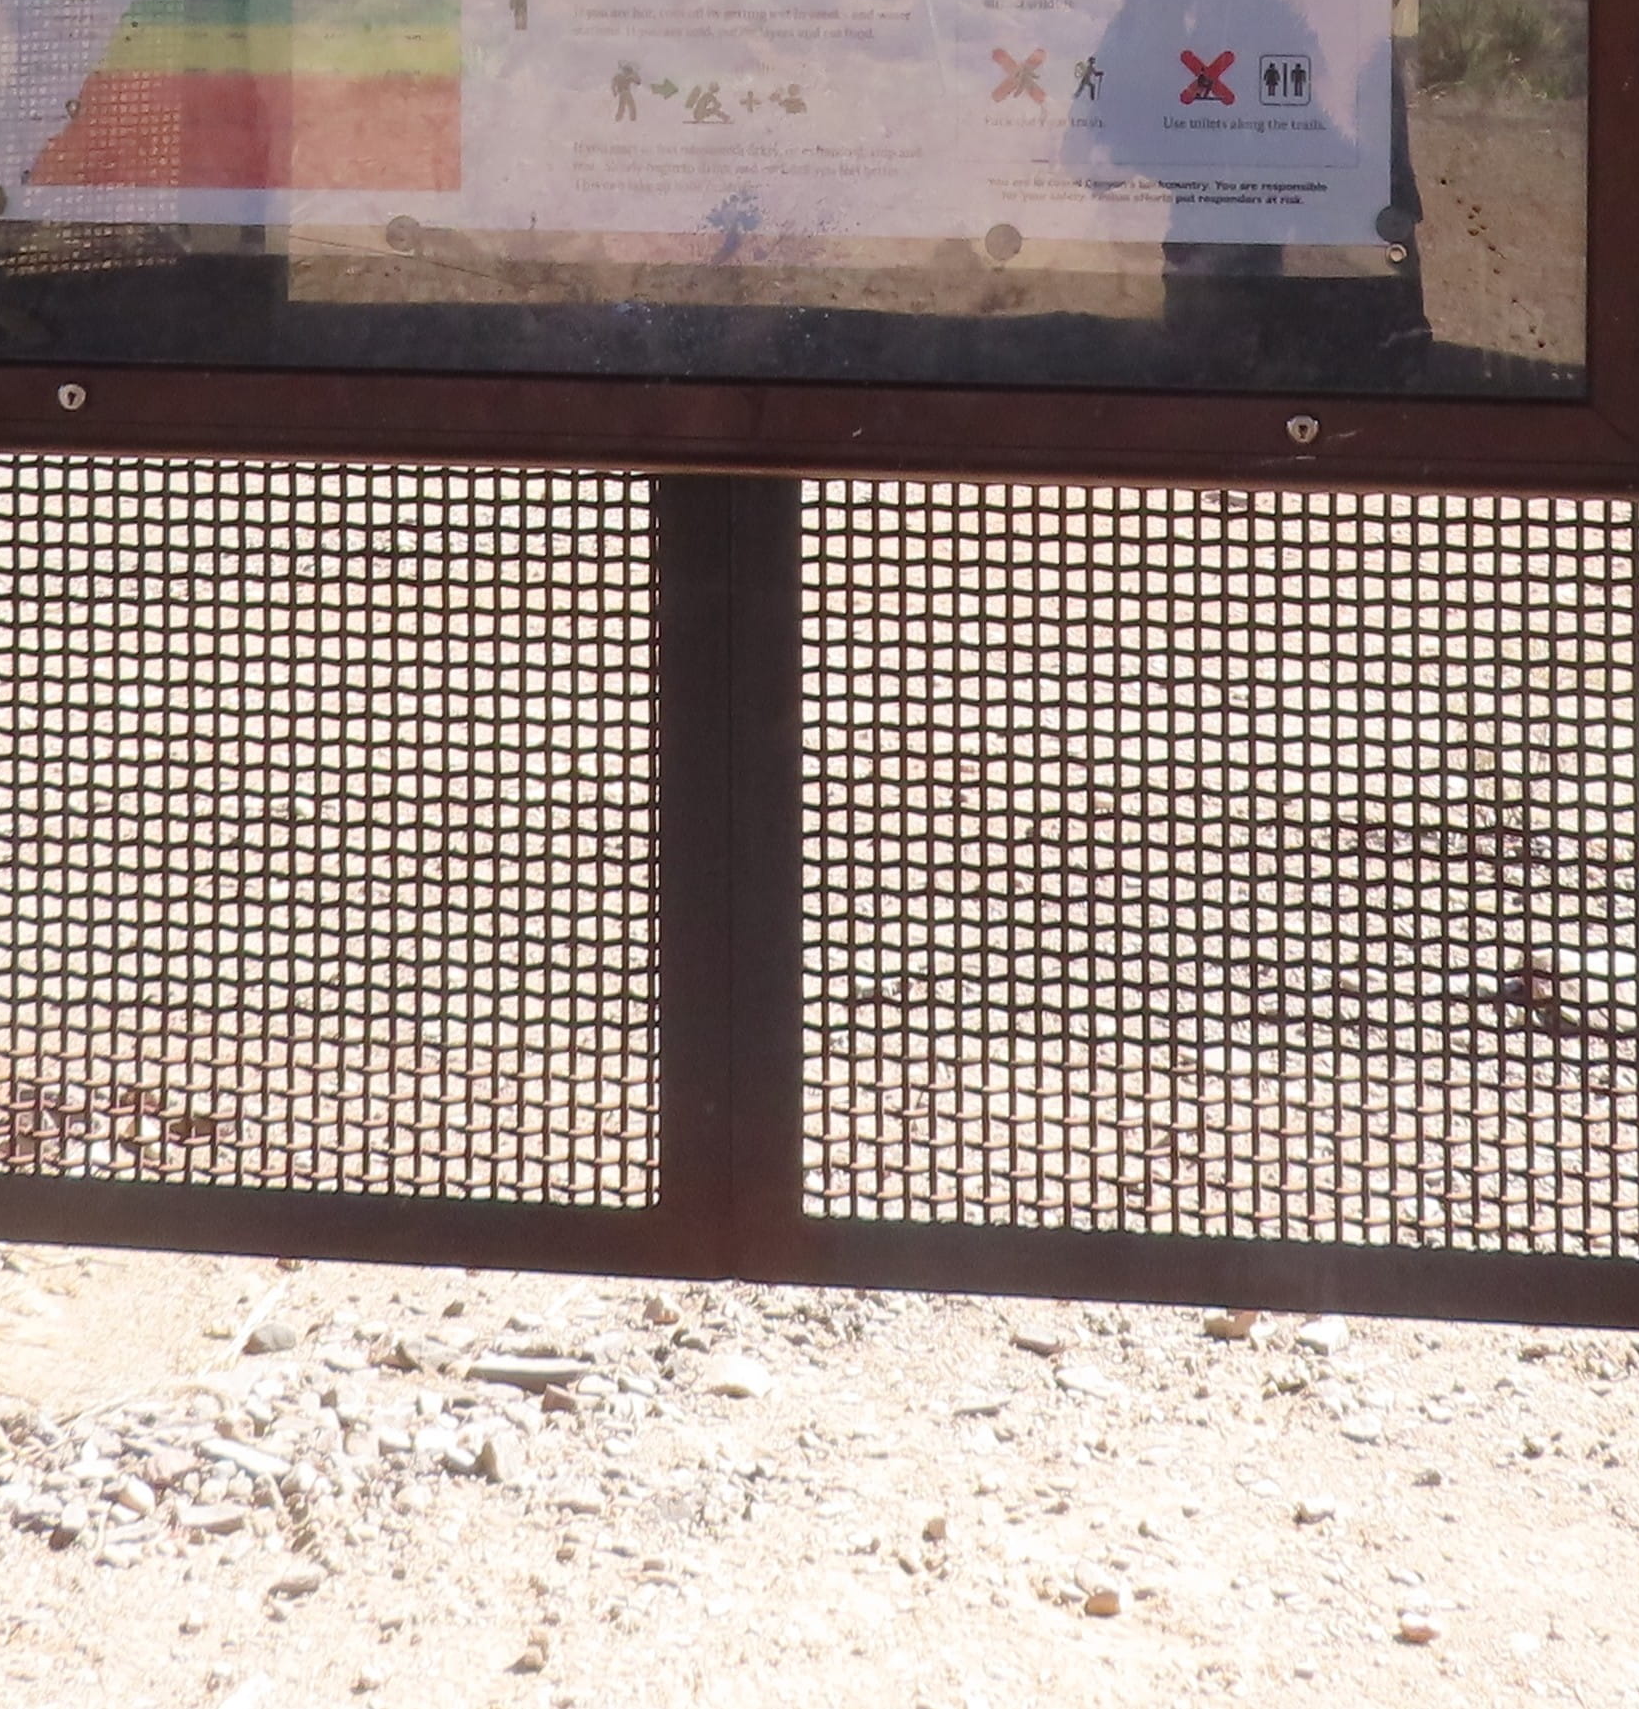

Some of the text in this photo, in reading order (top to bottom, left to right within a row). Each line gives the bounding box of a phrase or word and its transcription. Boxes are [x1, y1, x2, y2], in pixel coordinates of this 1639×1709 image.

[1163, 116, 1187, 130] Use
[1189, 117, 1228, 131] toilets
[1229, 118, 1265, 134] along
[1267, 117, 1289, 131] the
[1215, 180, 1237, 192] You
[1240, 182, 1258, 192] are
[1261, 180, 1329, 195] responsible
[1174, 193, 1195, 205] put
[1198, 194, 1262, 206] responders
[1265, 195, 1278, 206] at
